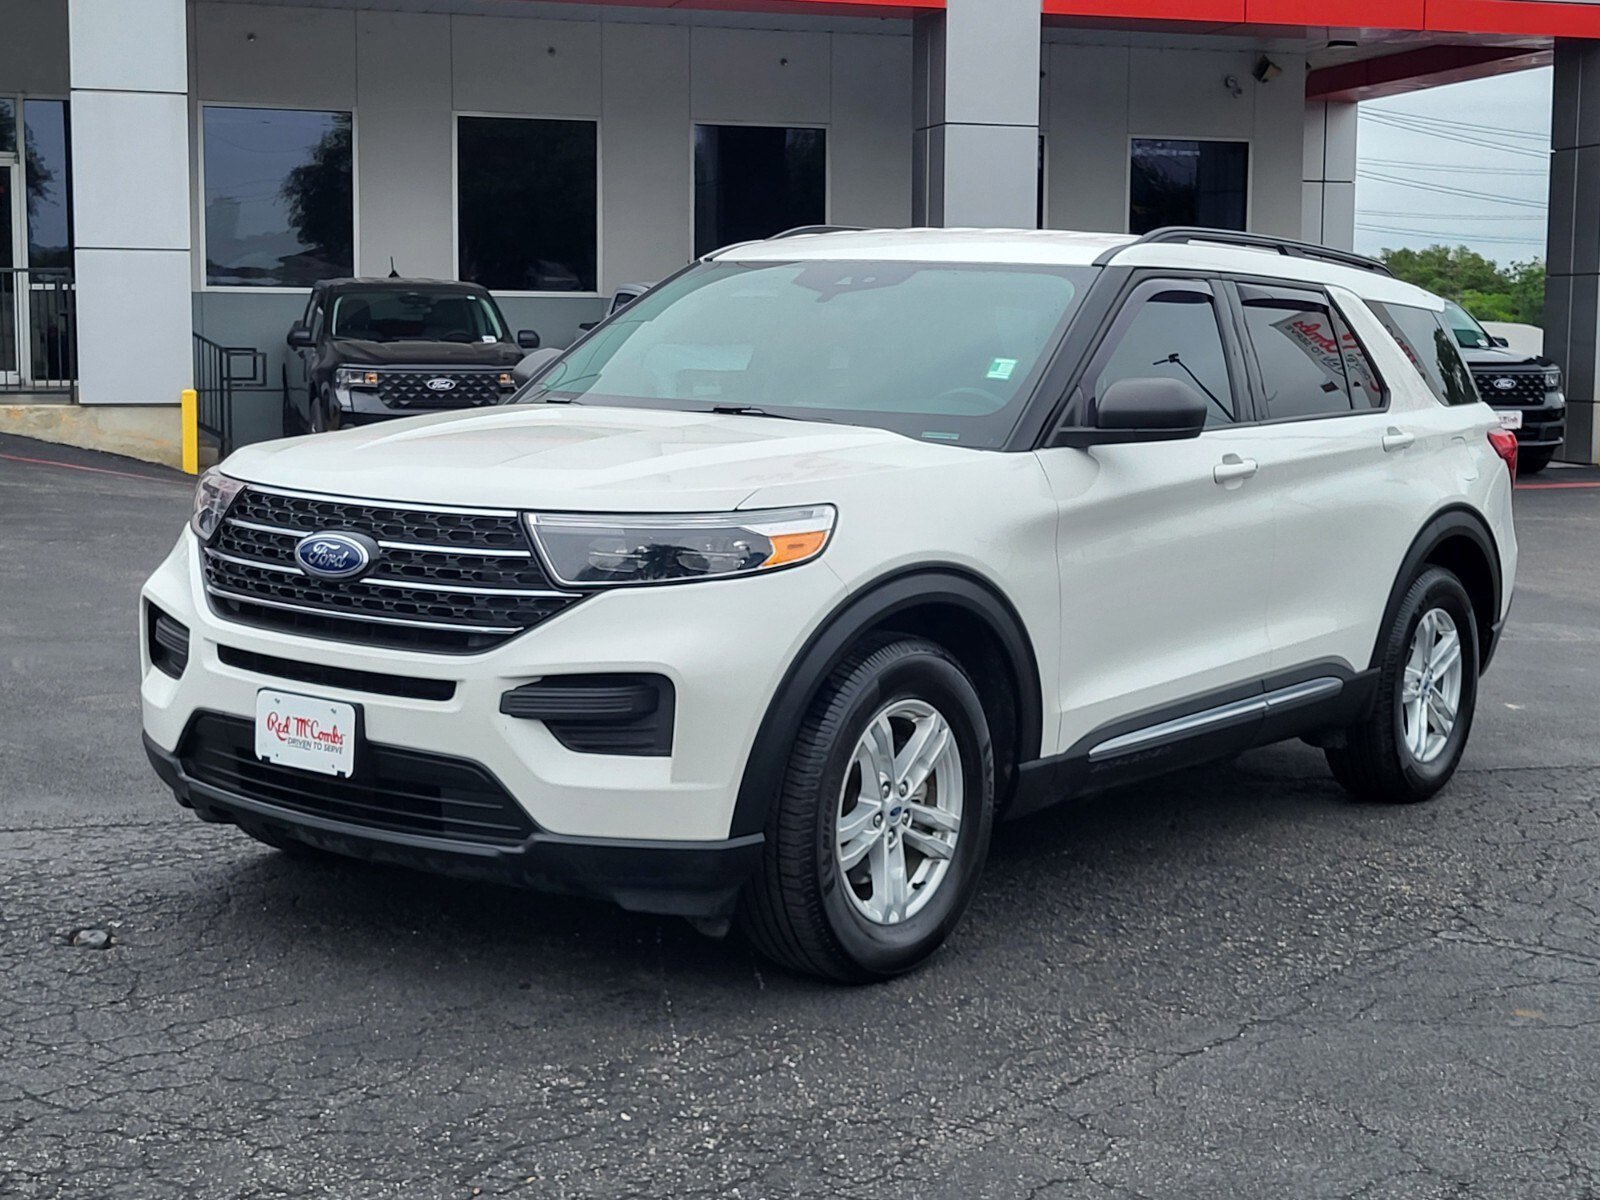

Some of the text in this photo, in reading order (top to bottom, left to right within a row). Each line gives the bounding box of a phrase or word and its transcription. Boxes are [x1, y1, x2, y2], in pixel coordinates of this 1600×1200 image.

[308, 541, 349, 568] Ford
[267, 711, 346, 745] Red McCombs
[287, 737, 343, 755] DRIVEN TO SERVE
